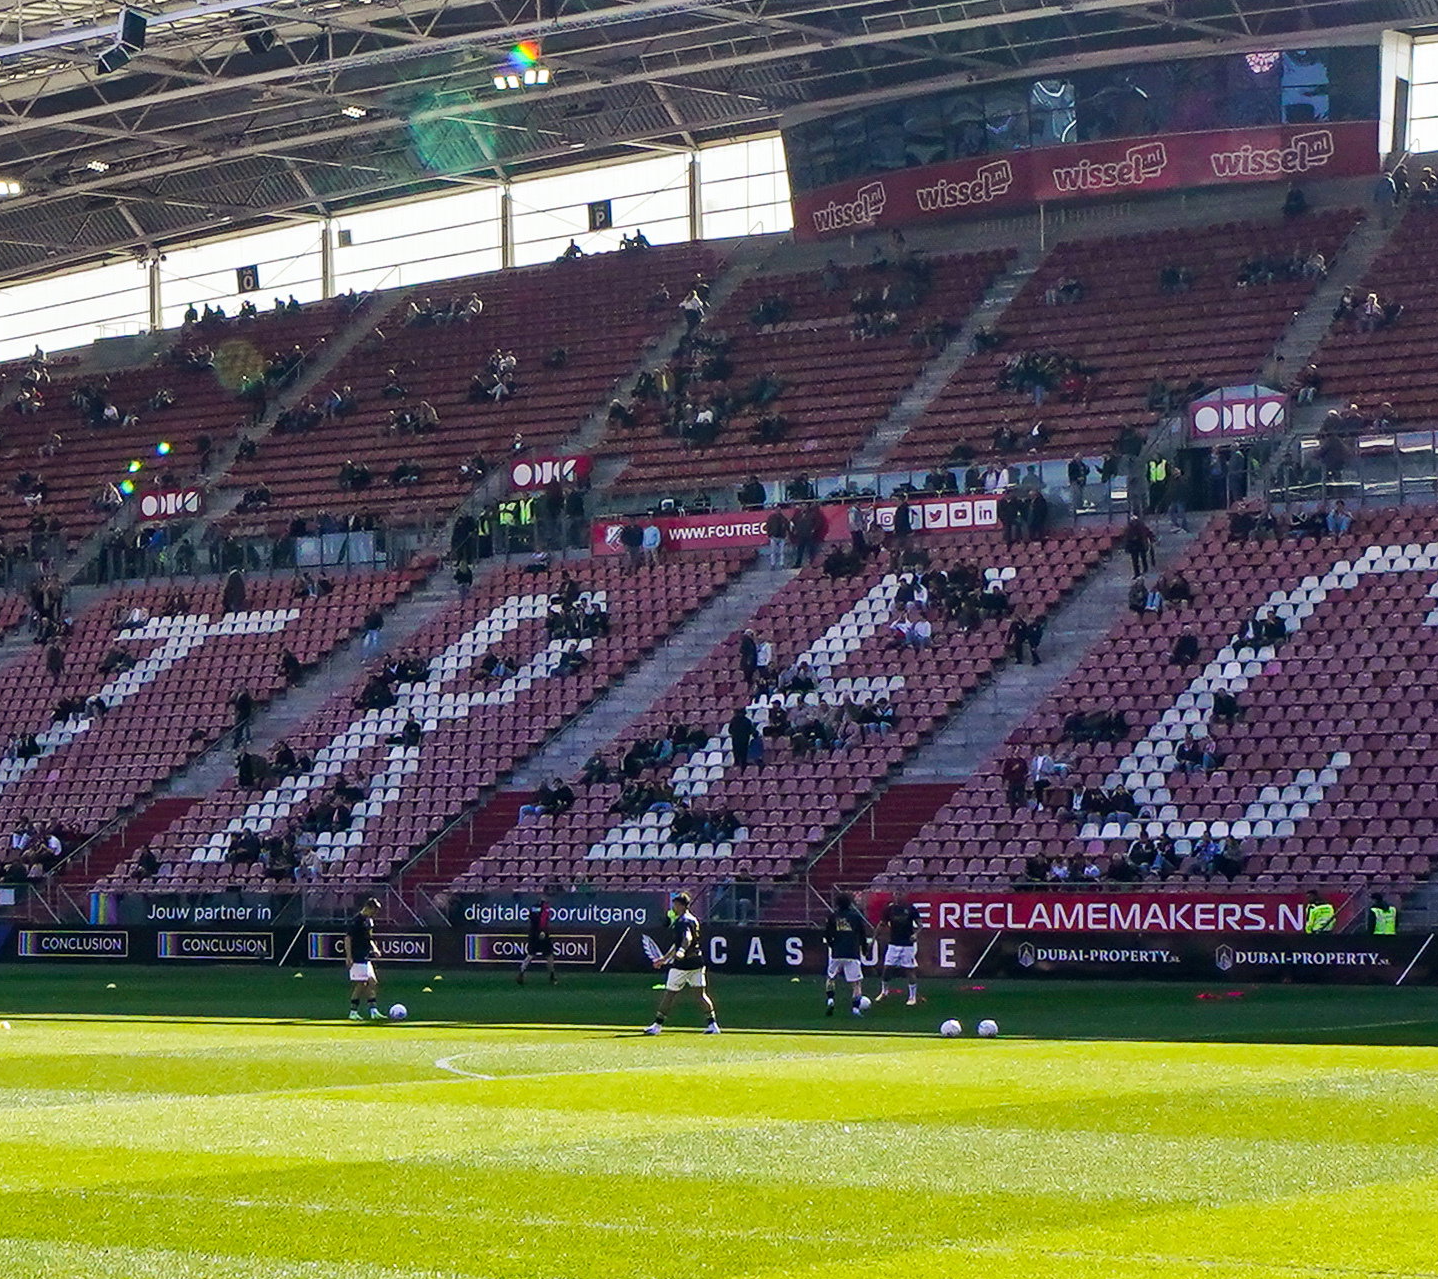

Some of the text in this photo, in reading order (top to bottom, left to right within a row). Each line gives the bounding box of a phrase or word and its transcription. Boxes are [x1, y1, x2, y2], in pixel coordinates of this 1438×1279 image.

[147, 904, 271, 923] Jouw partner in
[464, 902, 648, 926] digitale ooruitgang
[939, 902, 1305, 932] RECLAMEMAKERS.N
[41, 936, 122, 952] CONCLUSION
[182, 937, 268, 954] CONCLUSION
[334, 939, 426, 956] CUSION
[492, 941, 589, 957] CONSION
